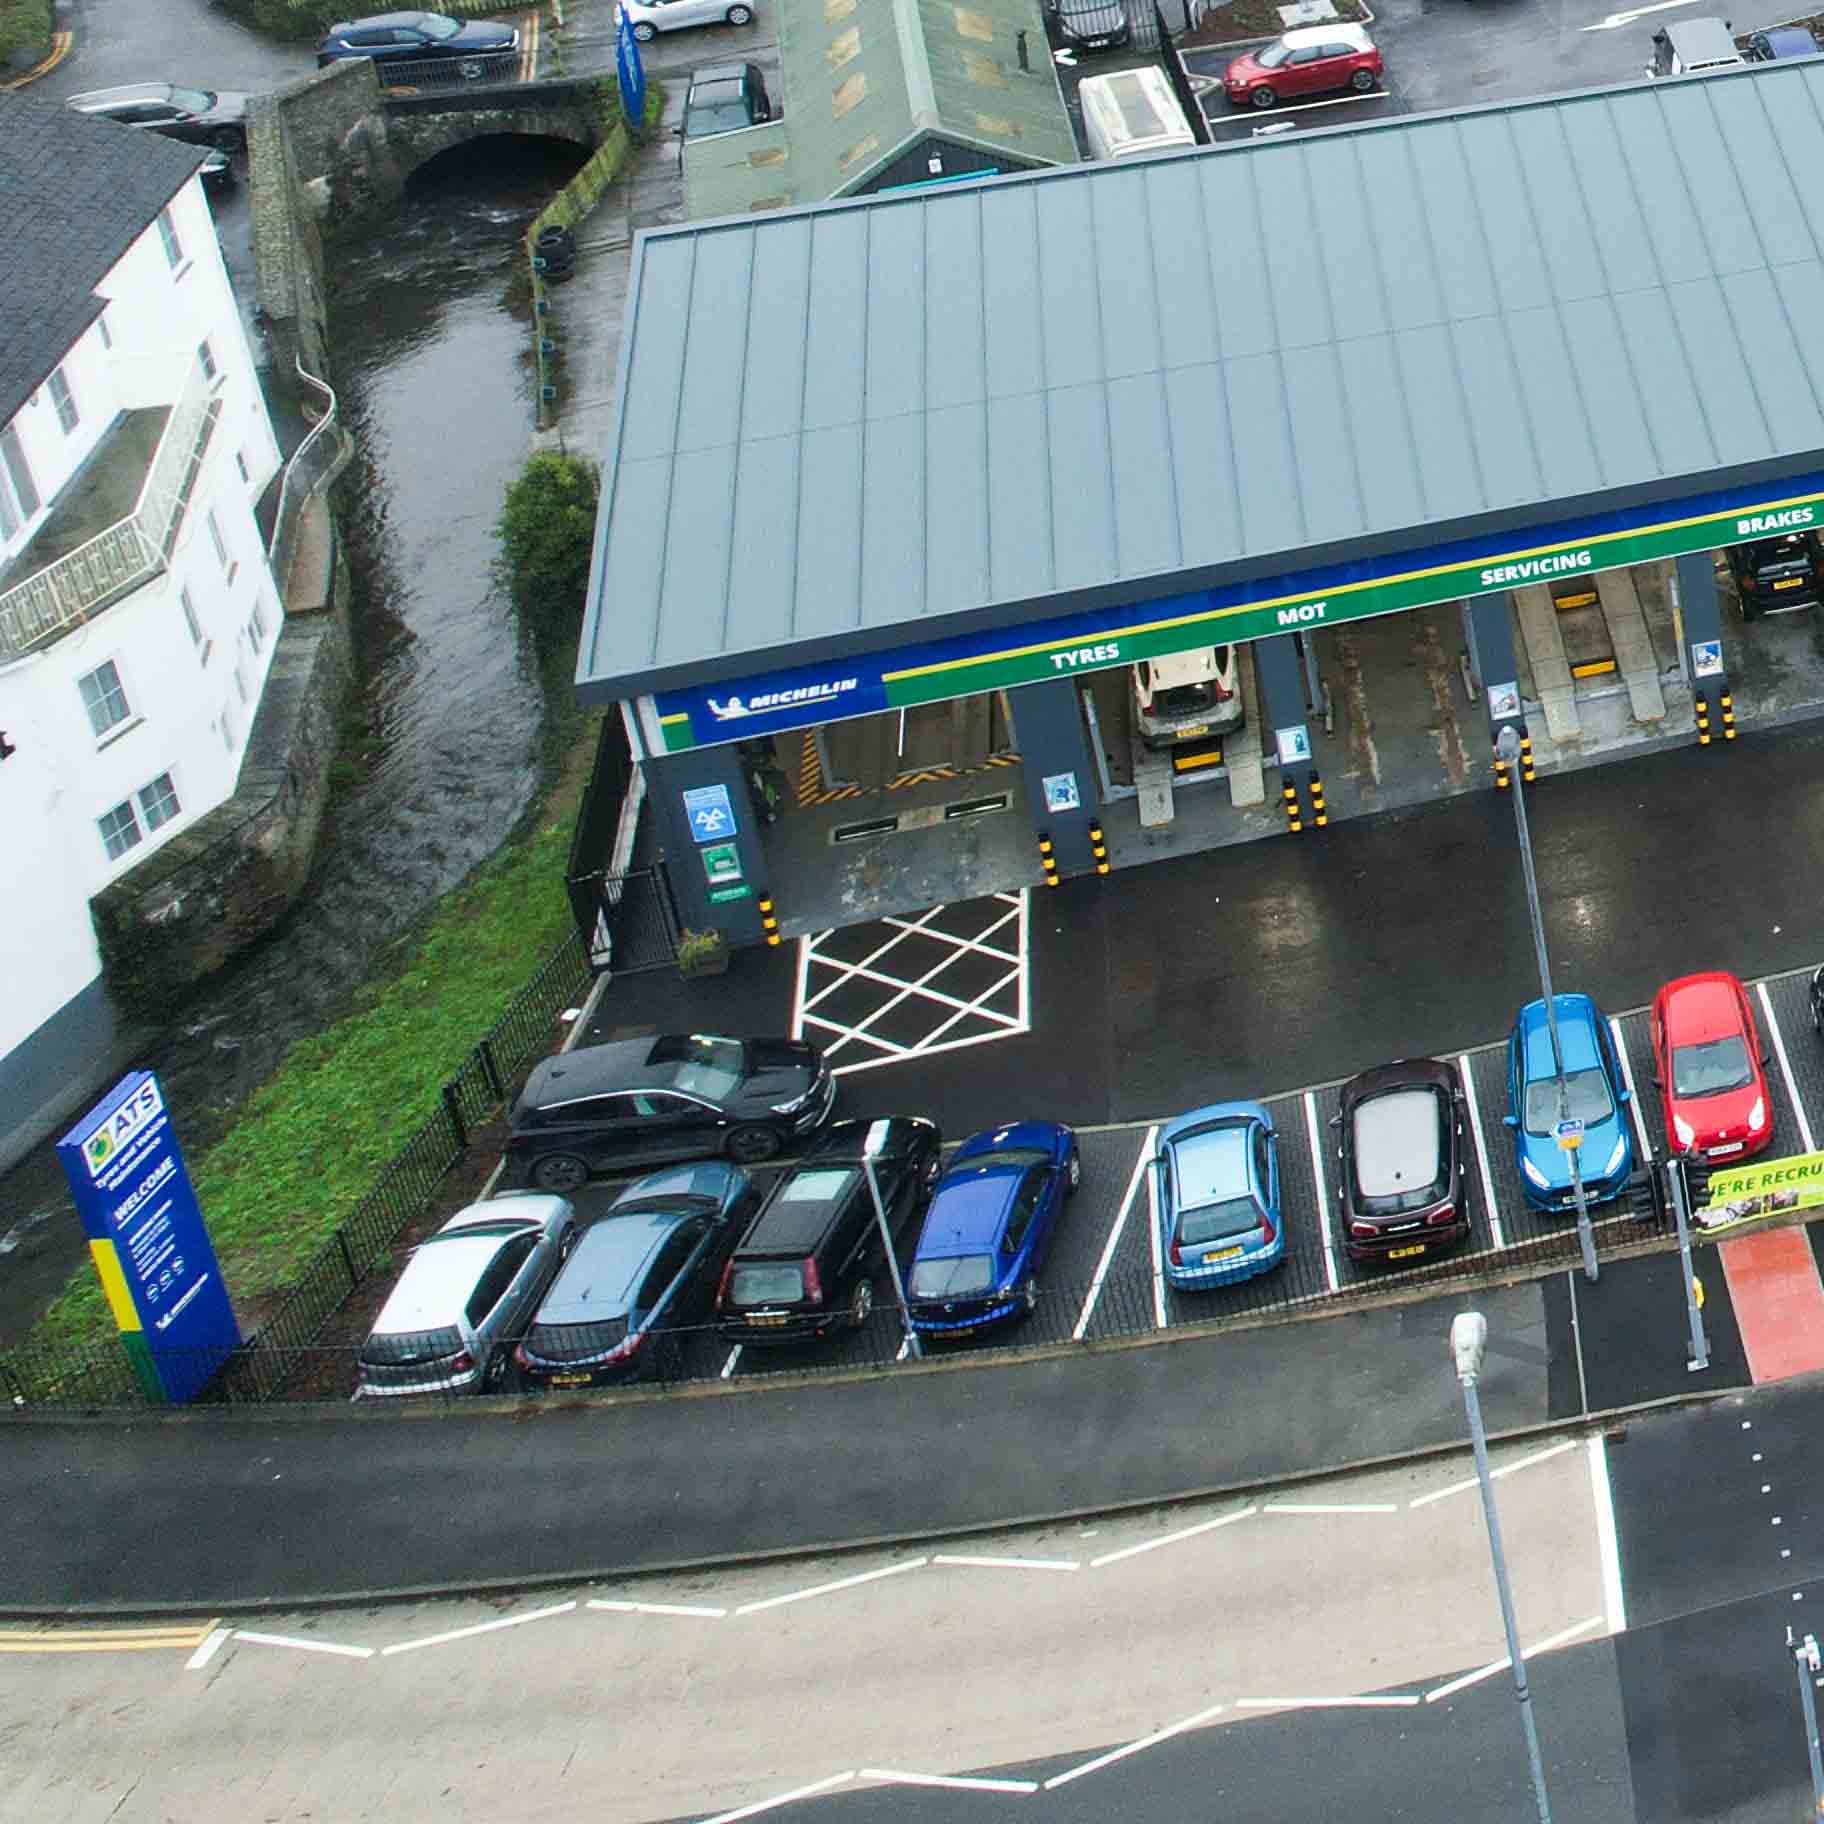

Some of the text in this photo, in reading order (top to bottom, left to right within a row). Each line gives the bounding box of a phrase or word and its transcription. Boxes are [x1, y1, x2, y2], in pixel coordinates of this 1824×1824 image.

[1736, 507, 1814, 535] BRAKES
[1480, 550, 1592, 586] SERVICING
[1276, 602, 1327, 626] MOT
[1050, 643, 1120, 670] TYRES
[750, 678, 858, 709] MICHELIN
[114, 1084, 155, 1139] ATS
[113, 1155, 176, 1220] WELCOME
